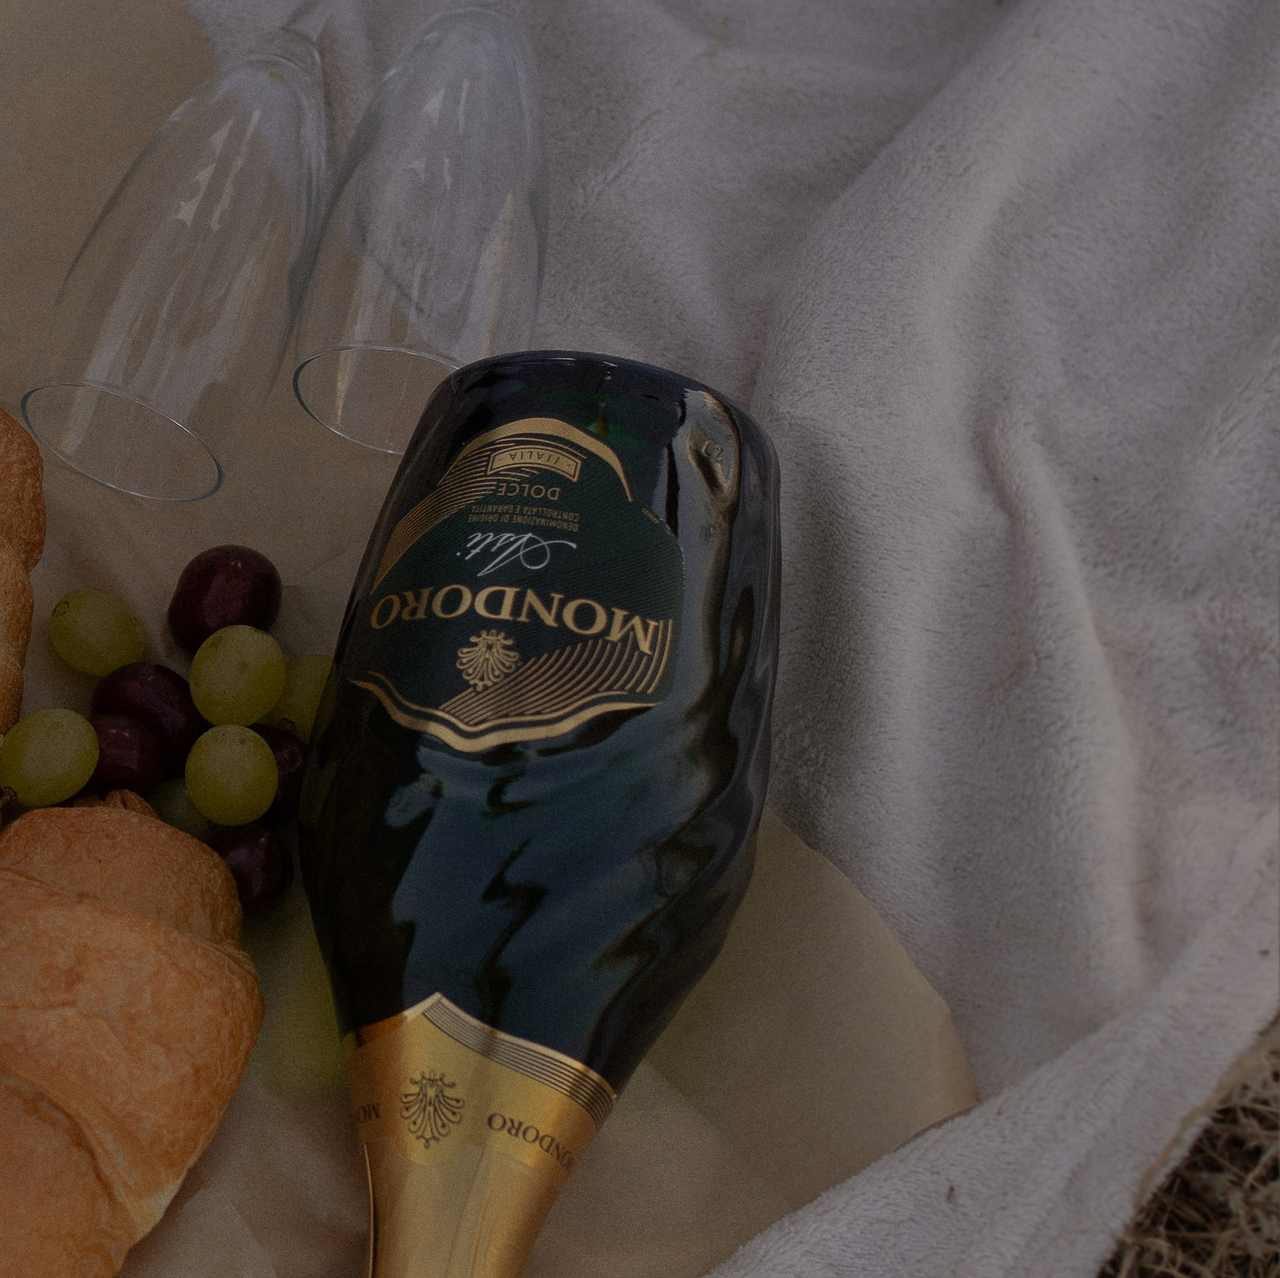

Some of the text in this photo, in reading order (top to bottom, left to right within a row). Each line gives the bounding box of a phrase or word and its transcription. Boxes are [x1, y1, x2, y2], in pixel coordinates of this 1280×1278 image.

[509, 452, 560, 467] ITALIA
[496, 483, 560, 501] DOLCE
[471, 504, 514, 513] GARANTITA
[522, 506, 580, 522] CONTROLLATA
[467, 513, 580, 532] DENOMINAZIONE DI ORIGINE
[456, 533, 577, 578] Asti
[370, 585, 658, 653] MONDORO
